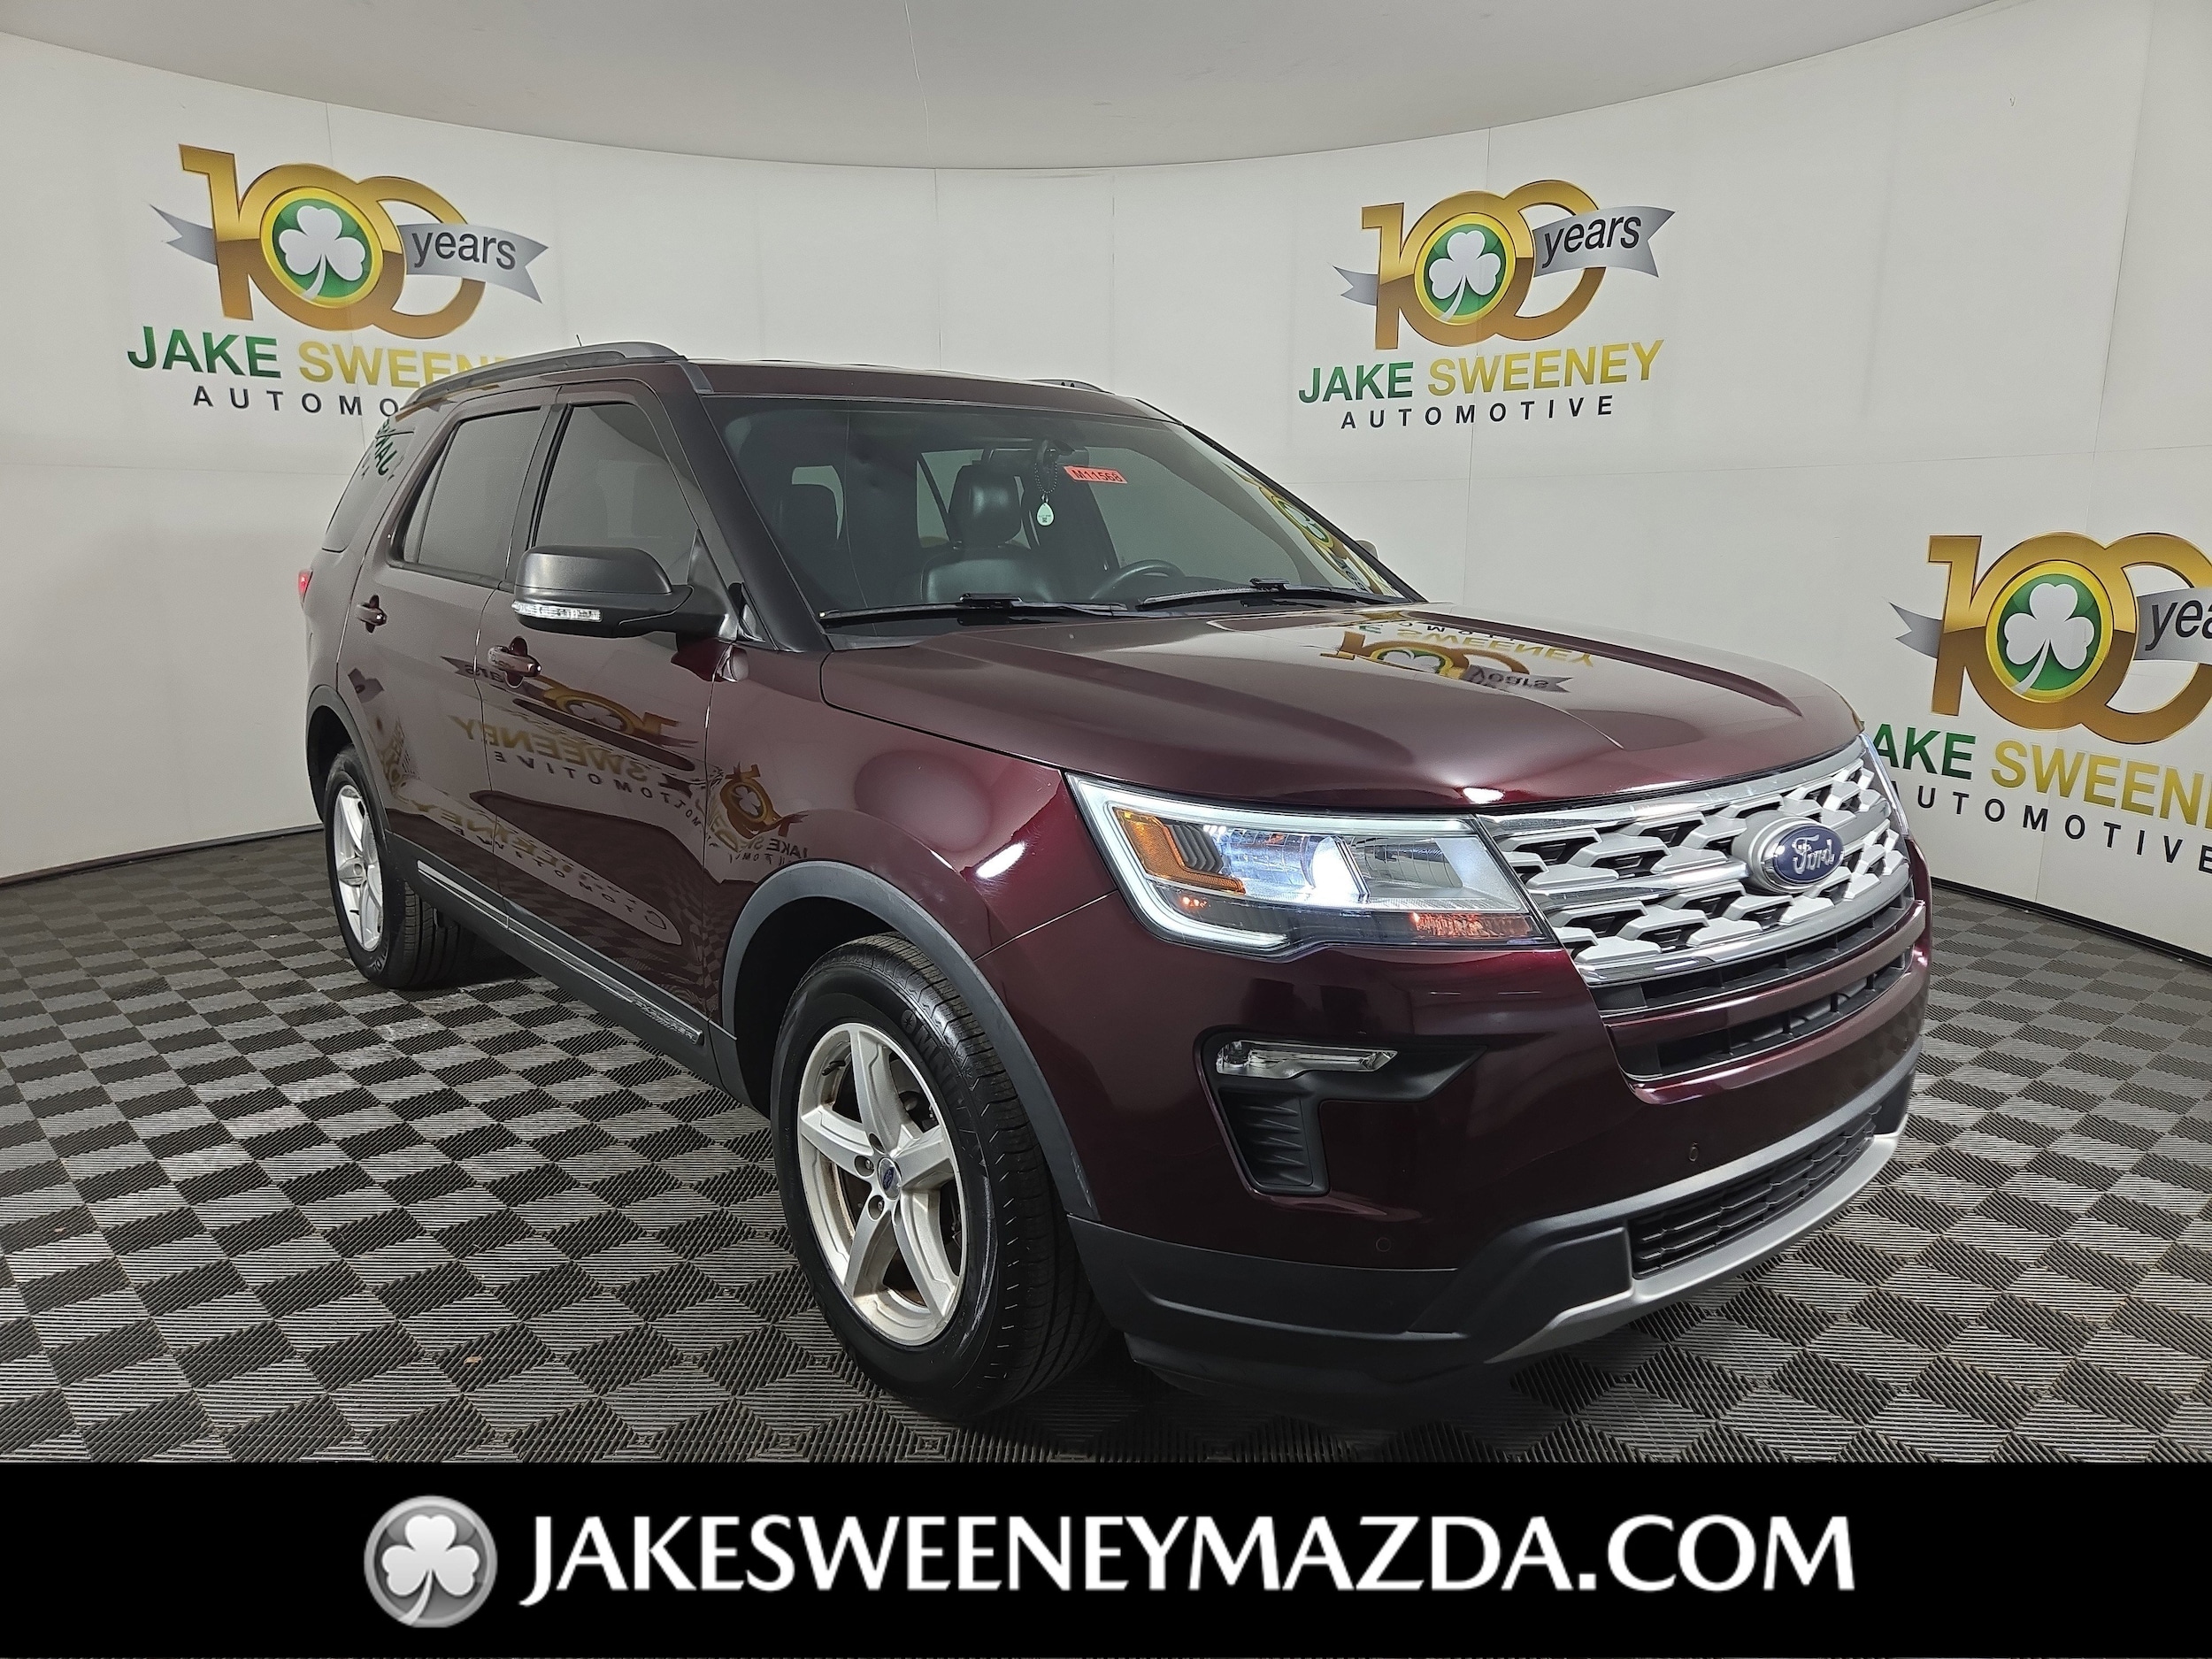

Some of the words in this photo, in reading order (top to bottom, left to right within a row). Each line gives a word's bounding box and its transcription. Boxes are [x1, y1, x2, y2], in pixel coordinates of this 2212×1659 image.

[179, 143, 487, 340] 100
[411, 228, 517, 272] years
[1361, 179, 1607, 350] 100
[1541, 212, 1642, 268] years
[127, 326, 282, 380] JAKE
[298, 341, 505, 388] SWEE
[1298, 361, 1415, 403] JAKE
[1427, 339, 1664, 397] SWEENEY
[193, 386, 399, 418] AUTOMO
[1340, 395, 1614, 429] AUTOMOTIVE
[1928, 531, 2212, 745] 100
[1860, 720, 1977, 780] AKE
[1991, 740, 2212, 831] SWEEN
[1792, 834, 1835, 875] Ford
[1890, 780, 2212, 873] UTOMOTIVE
